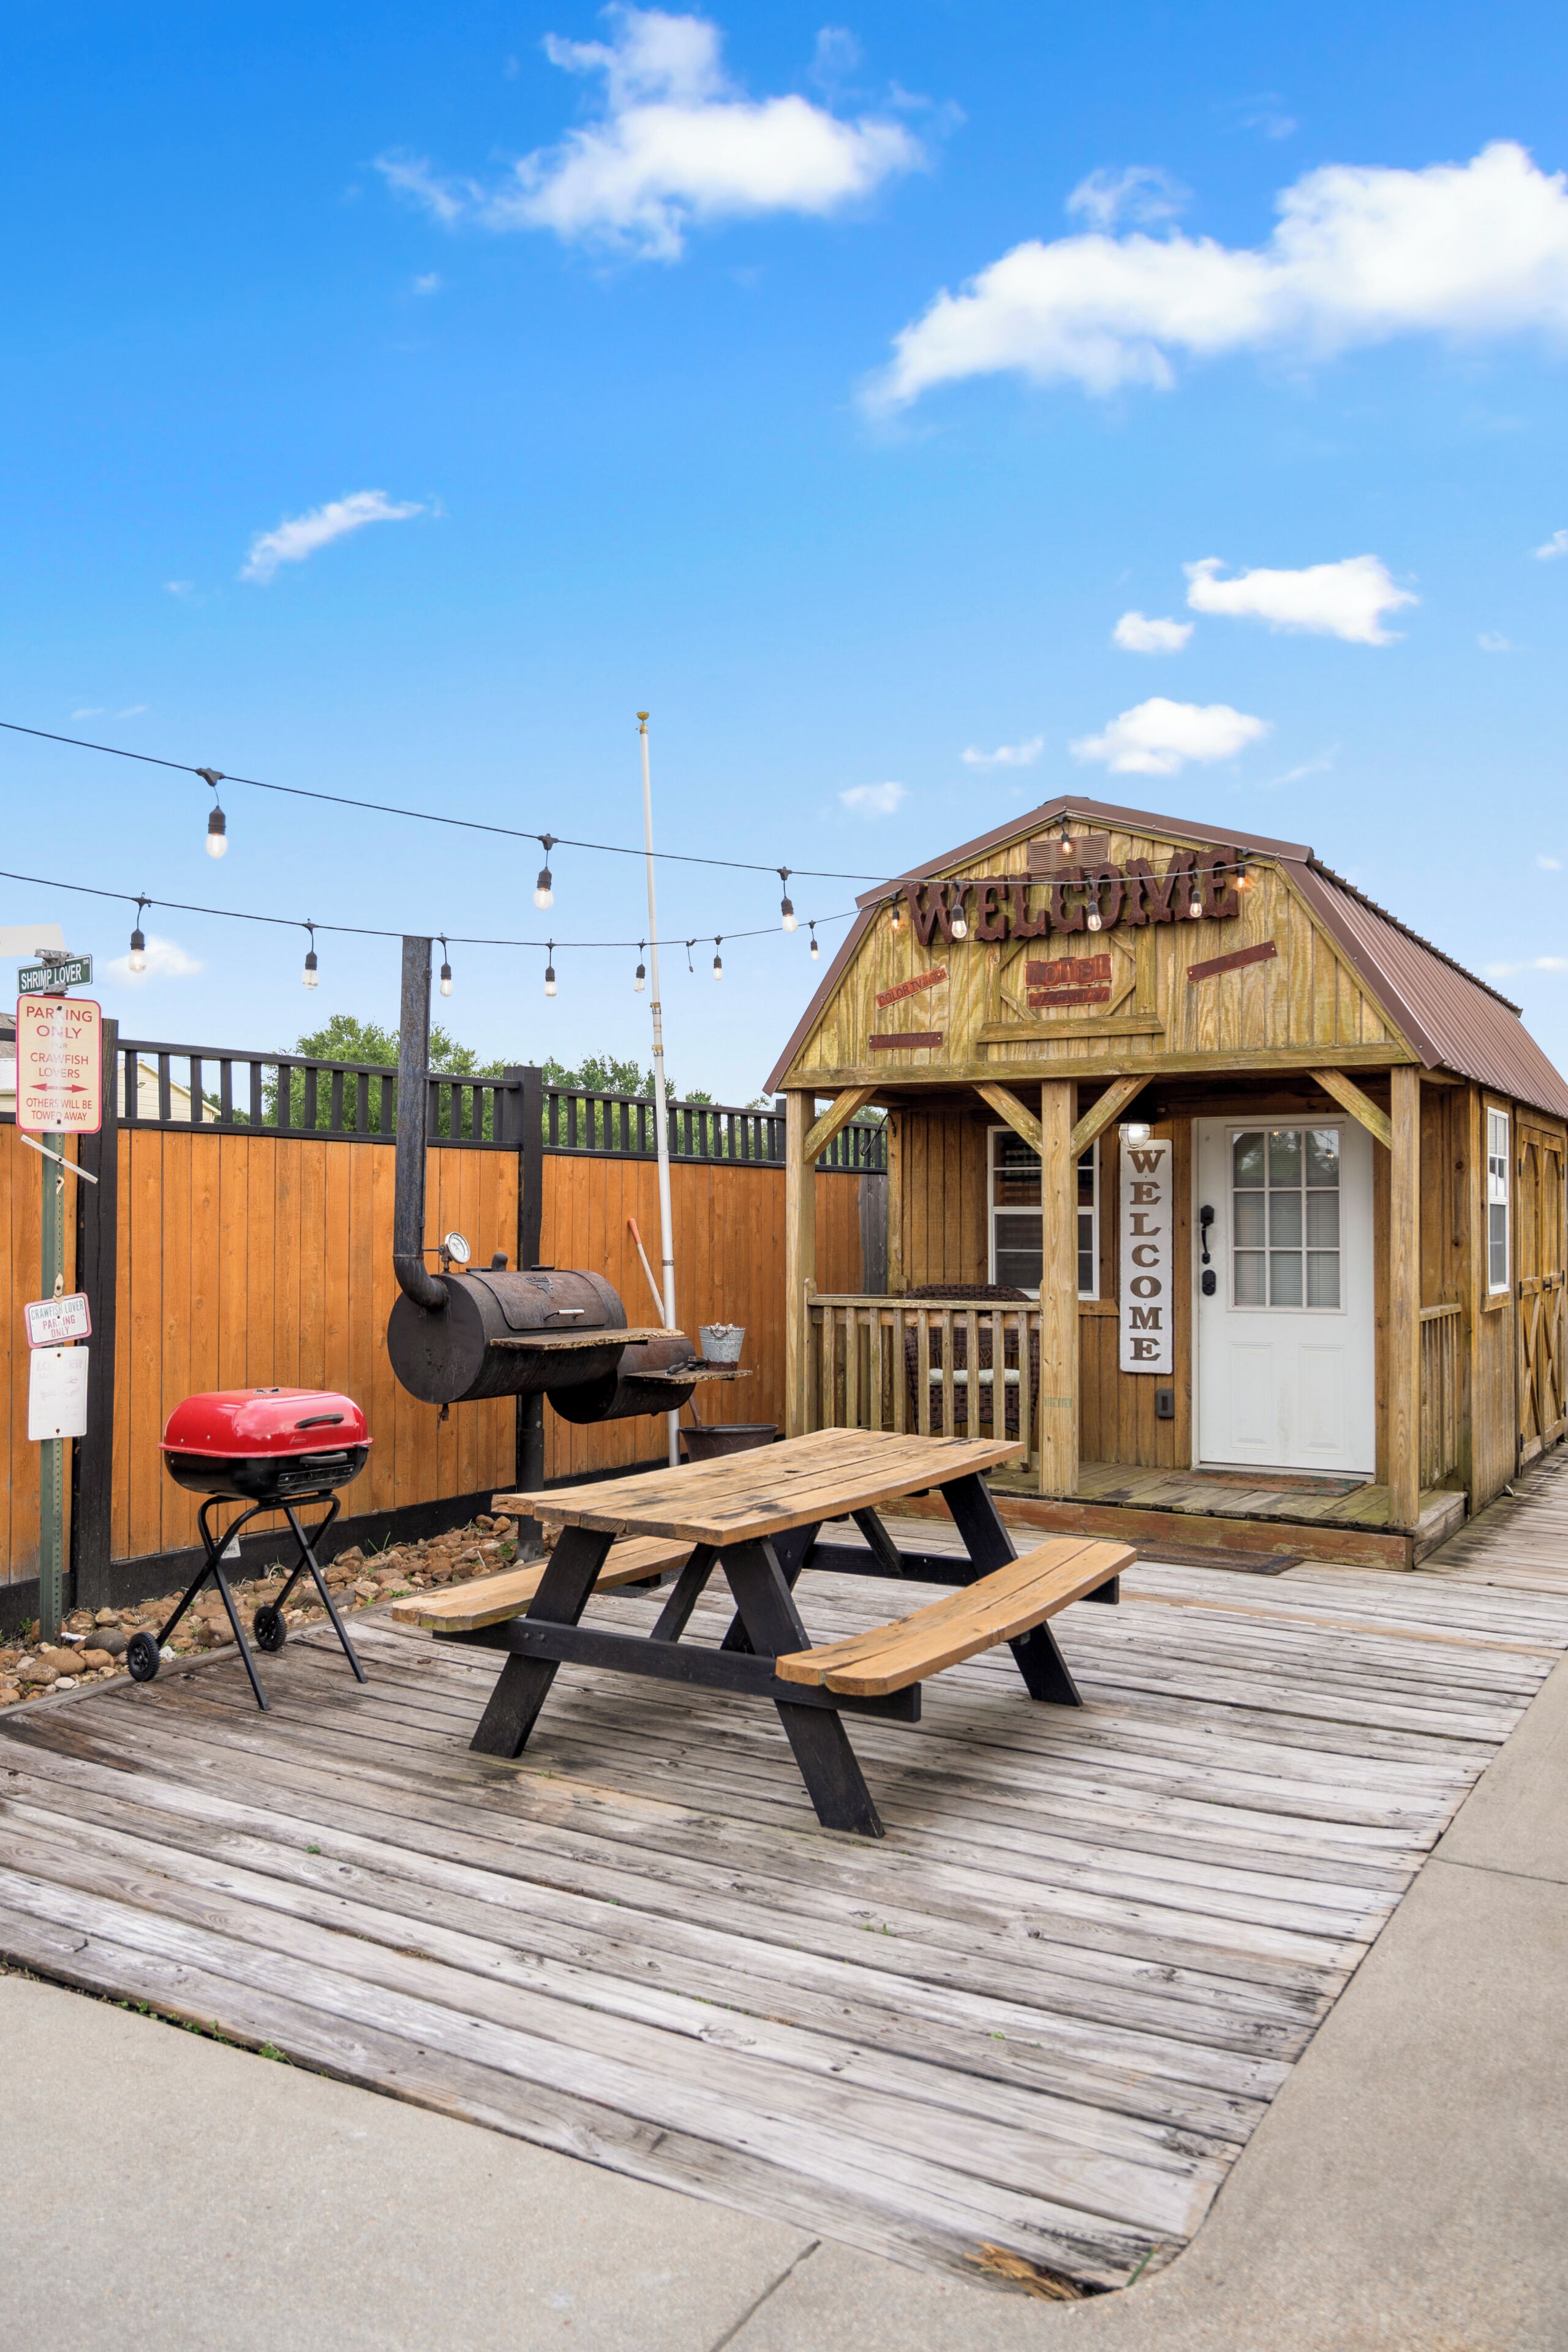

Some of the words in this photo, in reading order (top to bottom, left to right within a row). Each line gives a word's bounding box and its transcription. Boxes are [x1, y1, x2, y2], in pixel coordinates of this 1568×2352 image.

[903, 846, 1239, 946] WELCOME
[21, 968, 52, 990] SHRIMP
[55, 963, 82, 984] LOVER
[879, 985, 910, 1006] COLOR
[910, 979, 921, 991] TV
[37, 1025, 82, 1039] ONLY
[30, 1052, 88, 1065] CRAWFISH
[39, 1068, 80, 1079] LOVERS
[26, 1098, 59, 1108] OTHERS
[61, 1099, 80, 1109] WILL
[82, 1100, 92, 1109] BE
[31, 1110, 62, 1120] TOWED
[64, 1112, 87, 1121] AWAY
[1127, 1149, 1166, 1361] WELCOME
[31, 1303, 63, 1320] CRAWFISH
[64, 1300, 84, 1313] LOVER
[43, 1314, 75, 1330] PARING
[51, 1325, 69, 1338] ONLY
